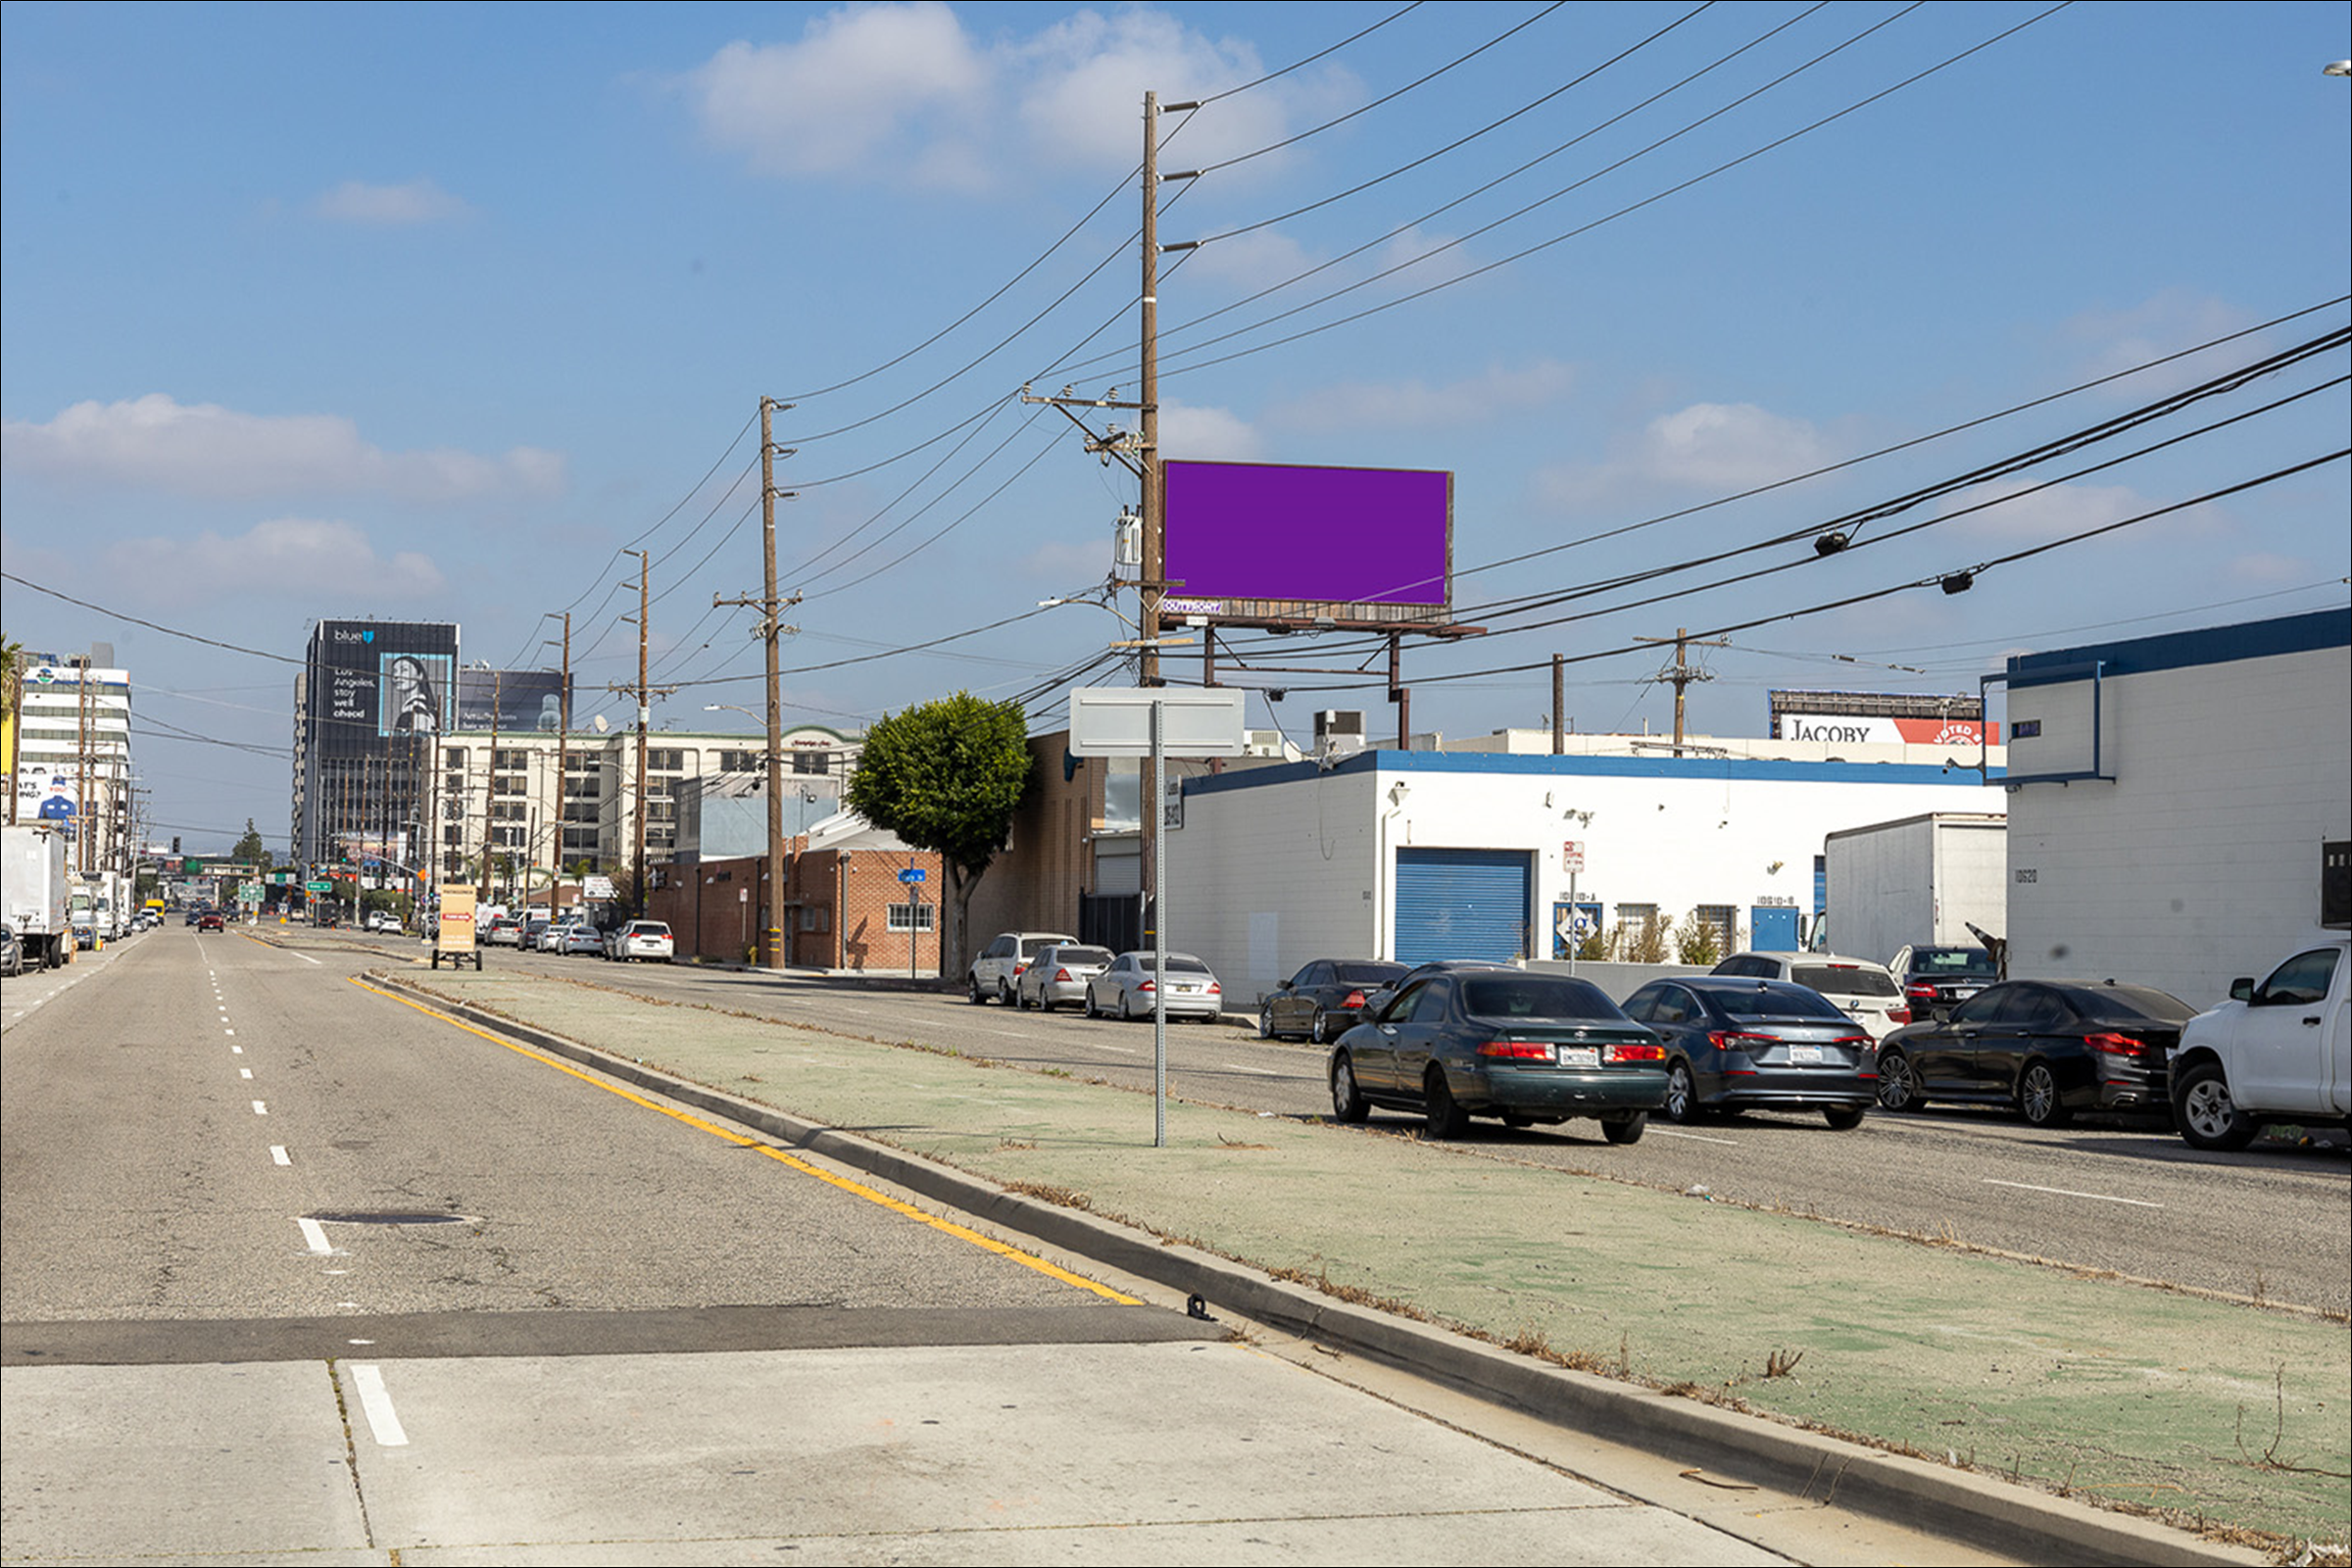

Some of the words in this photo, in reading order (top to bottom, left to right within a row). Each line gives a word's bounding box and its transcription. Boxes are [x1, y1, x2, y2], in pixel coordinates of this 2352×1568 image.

[334, 630, 362, 641] blue
[334, 689, 356, 699] stay
[333, 709, 365, 718] ahead
[1934, 724, 1973, 744] VOTED
[1559, 892, 1596, 901] 1010-A
